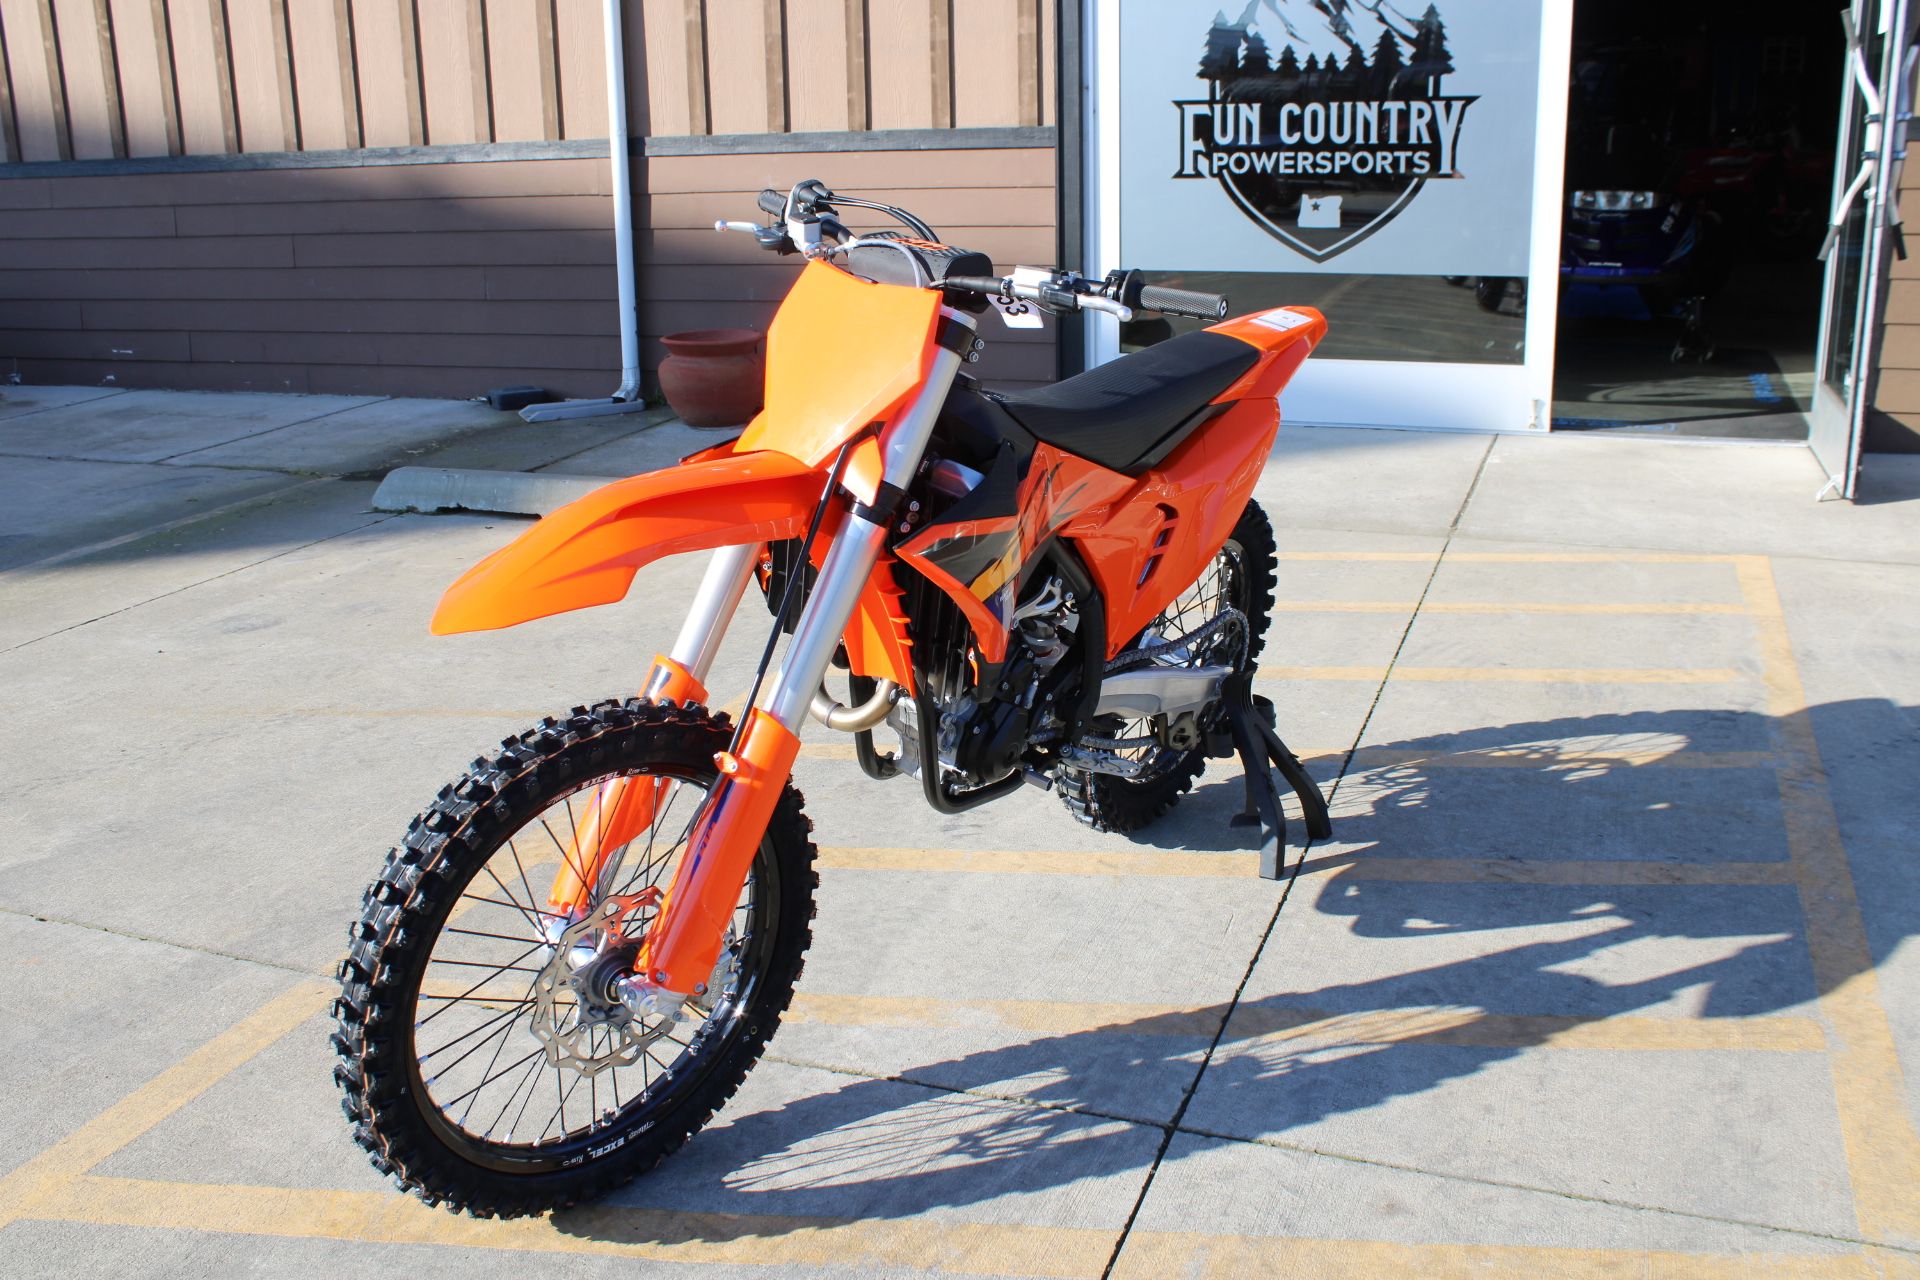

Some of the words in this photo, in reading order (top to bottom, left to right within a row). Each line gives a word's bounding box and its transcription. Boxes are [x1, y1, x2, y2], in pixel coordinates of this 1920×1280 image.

[1181, 102, 1261, 175] FUN
[1279, 100, 1466, 175] COUNTRY
[1212, 151, 1431, 174] POWERSPORTS
[581, 770, 620, 789] EXCEL
[589, 1136, 626, 1159] EXCEL
